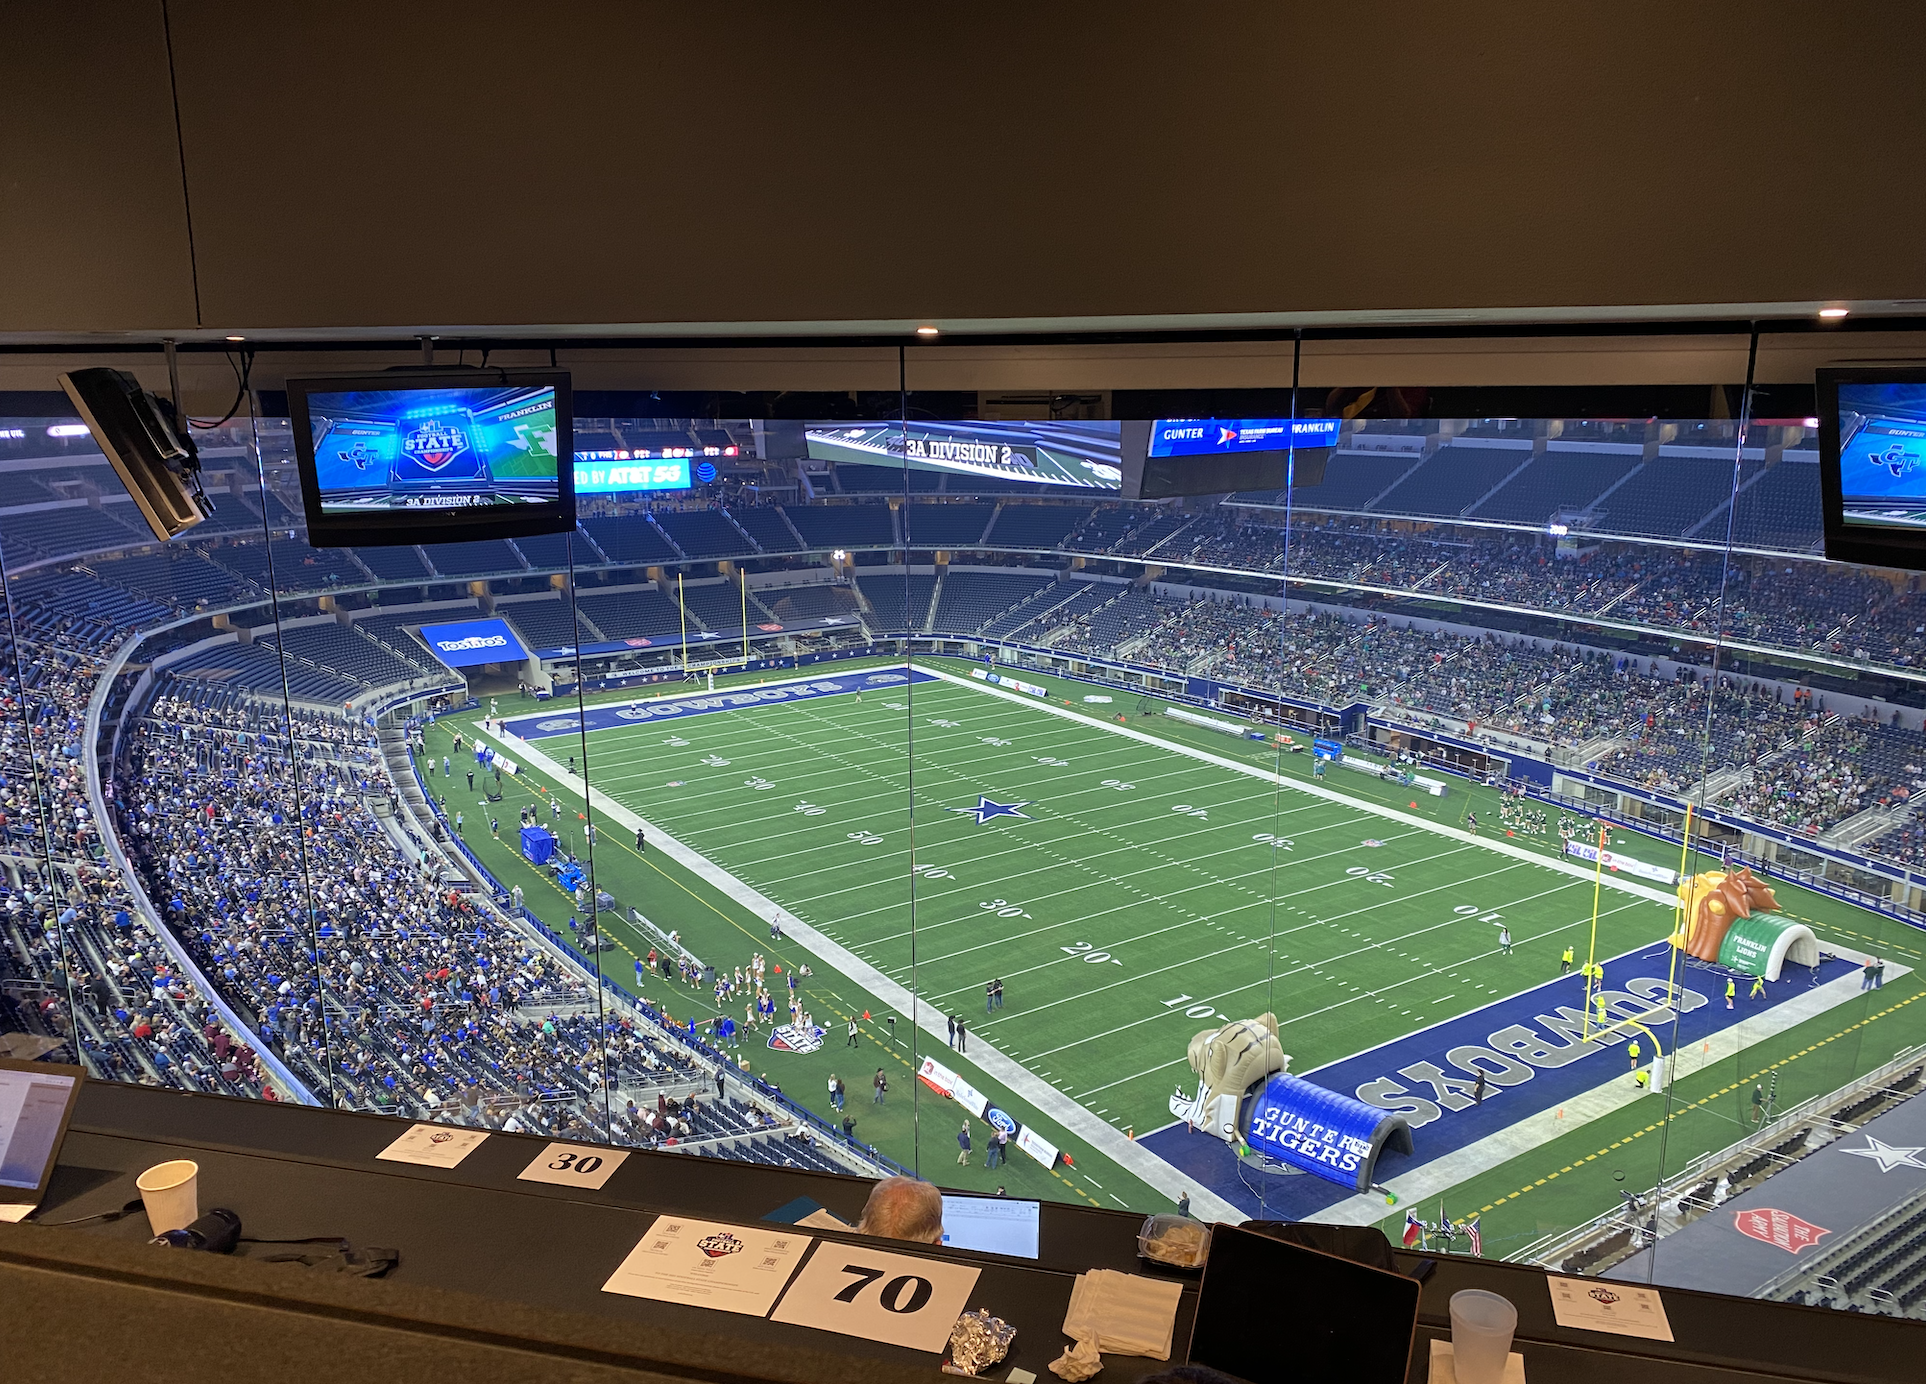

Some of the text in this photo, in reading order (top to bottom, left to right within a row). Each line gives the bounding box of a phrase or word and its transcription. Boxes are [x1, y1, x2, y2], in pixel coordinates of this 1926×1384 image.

[498, 401, 553, 421] FRANKLIN
[1164, 428, 1204, 440] GUNTER
[1292, 422, 1334, 434] FRANKLIN
[1889, 429, 1925, 437] GUNTER
[405, 434, 463, 450] STATE
[907, 440, 926, 457] 3A
[928, 441, 997, 463] DIVISION
[1000, 446, 1012, 464] 2
[592, 469, 605, 484] BY
[608, 466, 650, 485] AT&T
[653, 465, 681, 482] 5G
[423, 496, 470, 506] DIVISION
[622, 668, 654, 676] WELCOME
[687, 658, 740, 669] CHAMPIONSHIPS
[616, 681, 843, 720] COWBOYS
[847, 830, 884, 846] 50
[979, 898, 1024, 918] 30
[1060, 942, 1112, 964] 20
[1732, 935, 1768, 953] FRANKLIN
[1736, 946, 1758, 959] LIONS
[1159, 993, 1216, 1019] 10
[1355, 977, 1710, 1129] COWBOYS
[992, 1112, 1011, 1132] Ford
[1265, 1107, 1353, 1150] GUNTER
[1252, 1118, 1361, 1172] TIGERS
[548, 1152, 604, 1174] 30
[1793, 1224, 1810, 1242] THE
[698, 1240, 743, 1252] STATE
[833, 1264, 933, 1314] 70
